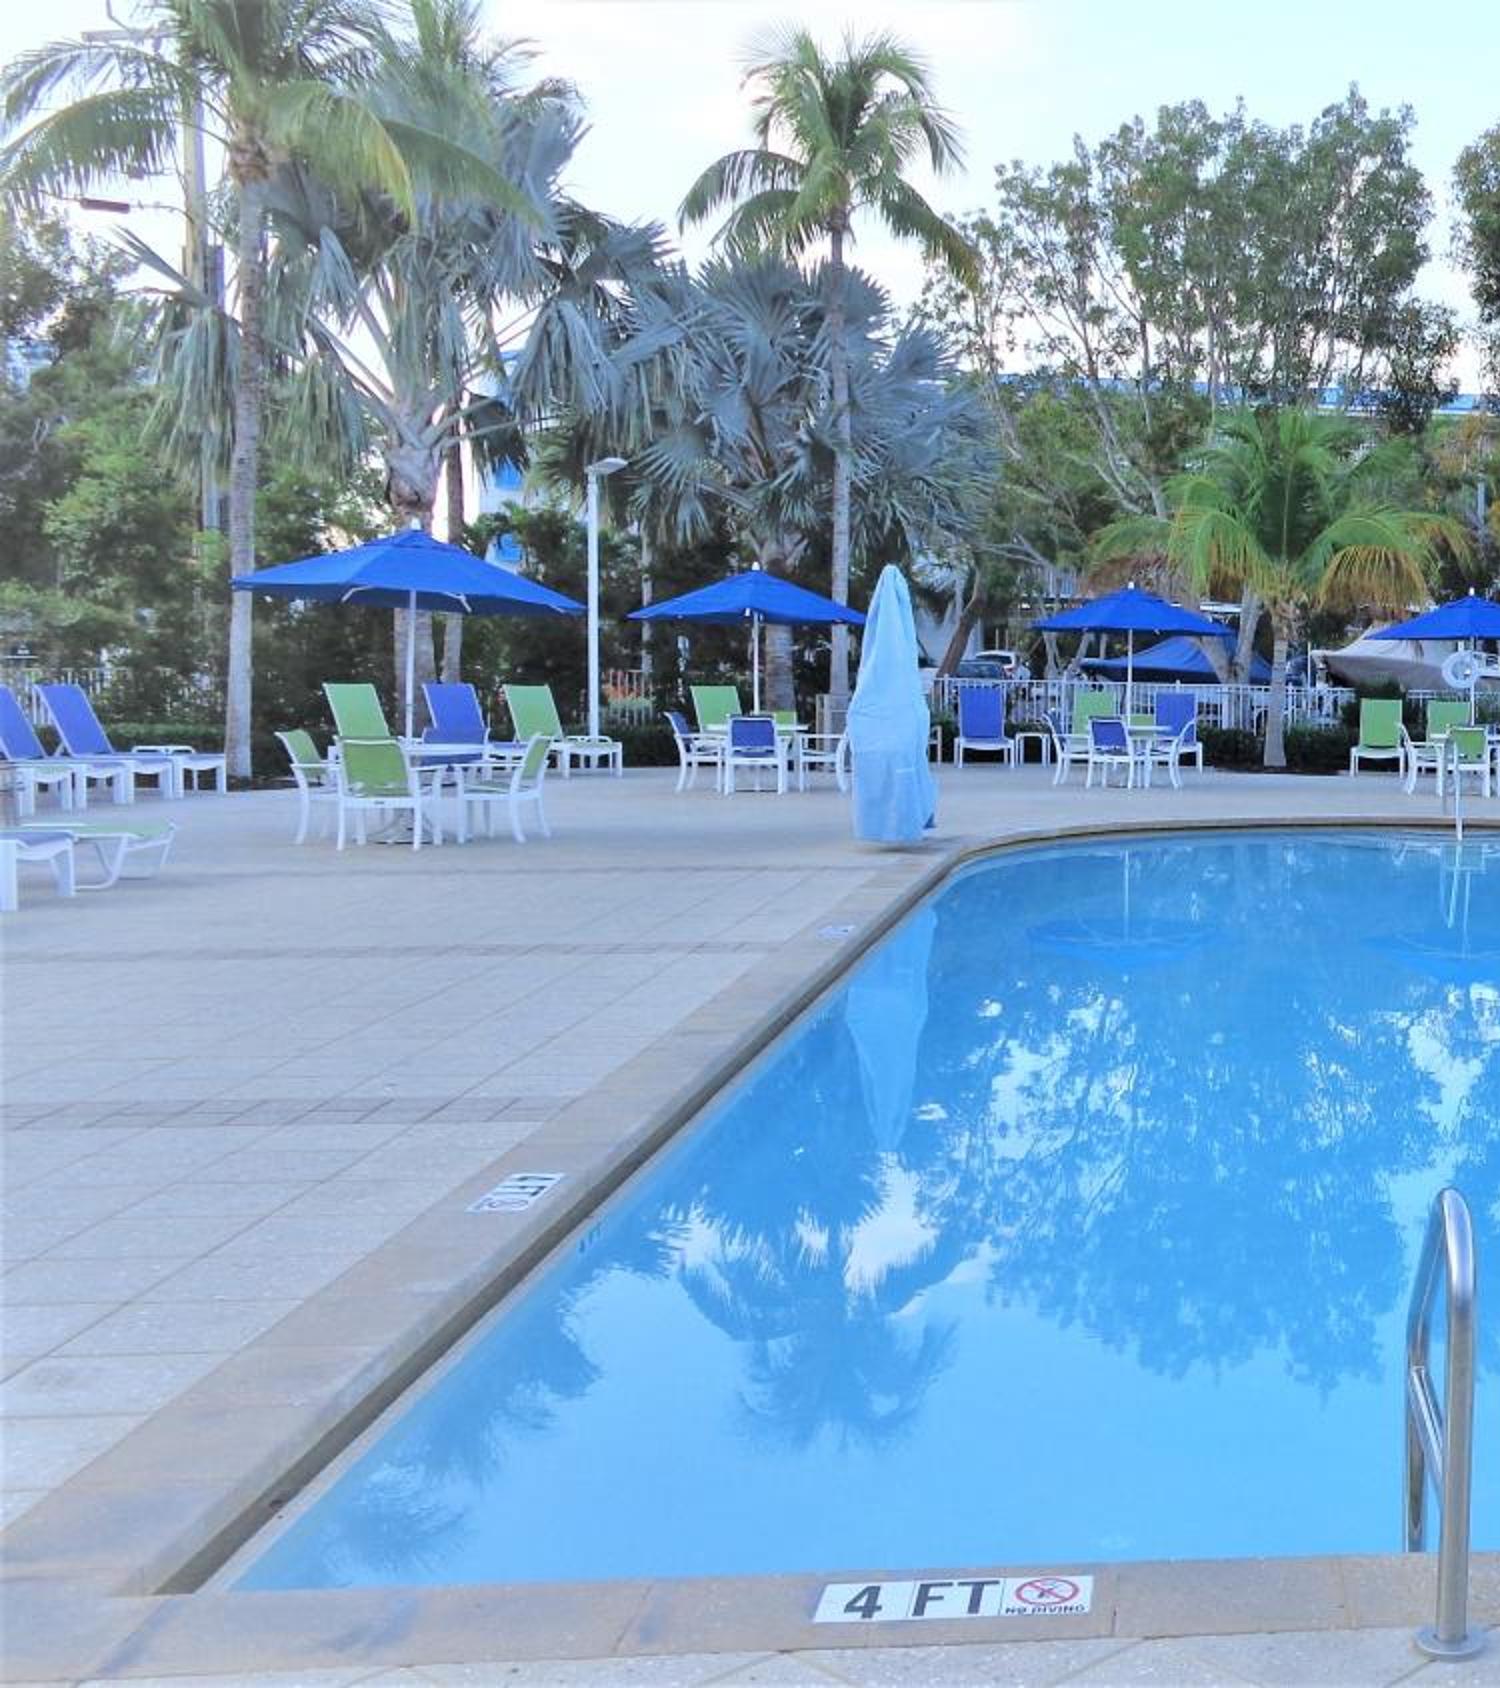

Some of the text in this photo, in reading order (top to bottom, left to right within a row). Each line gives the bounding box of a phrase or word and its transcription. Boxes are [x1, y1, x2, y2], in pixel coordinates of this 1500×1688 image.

[843, 1580, 1000, 1619] 4 FT
[1005, 1603, 1086, 1615] NO DIVING
